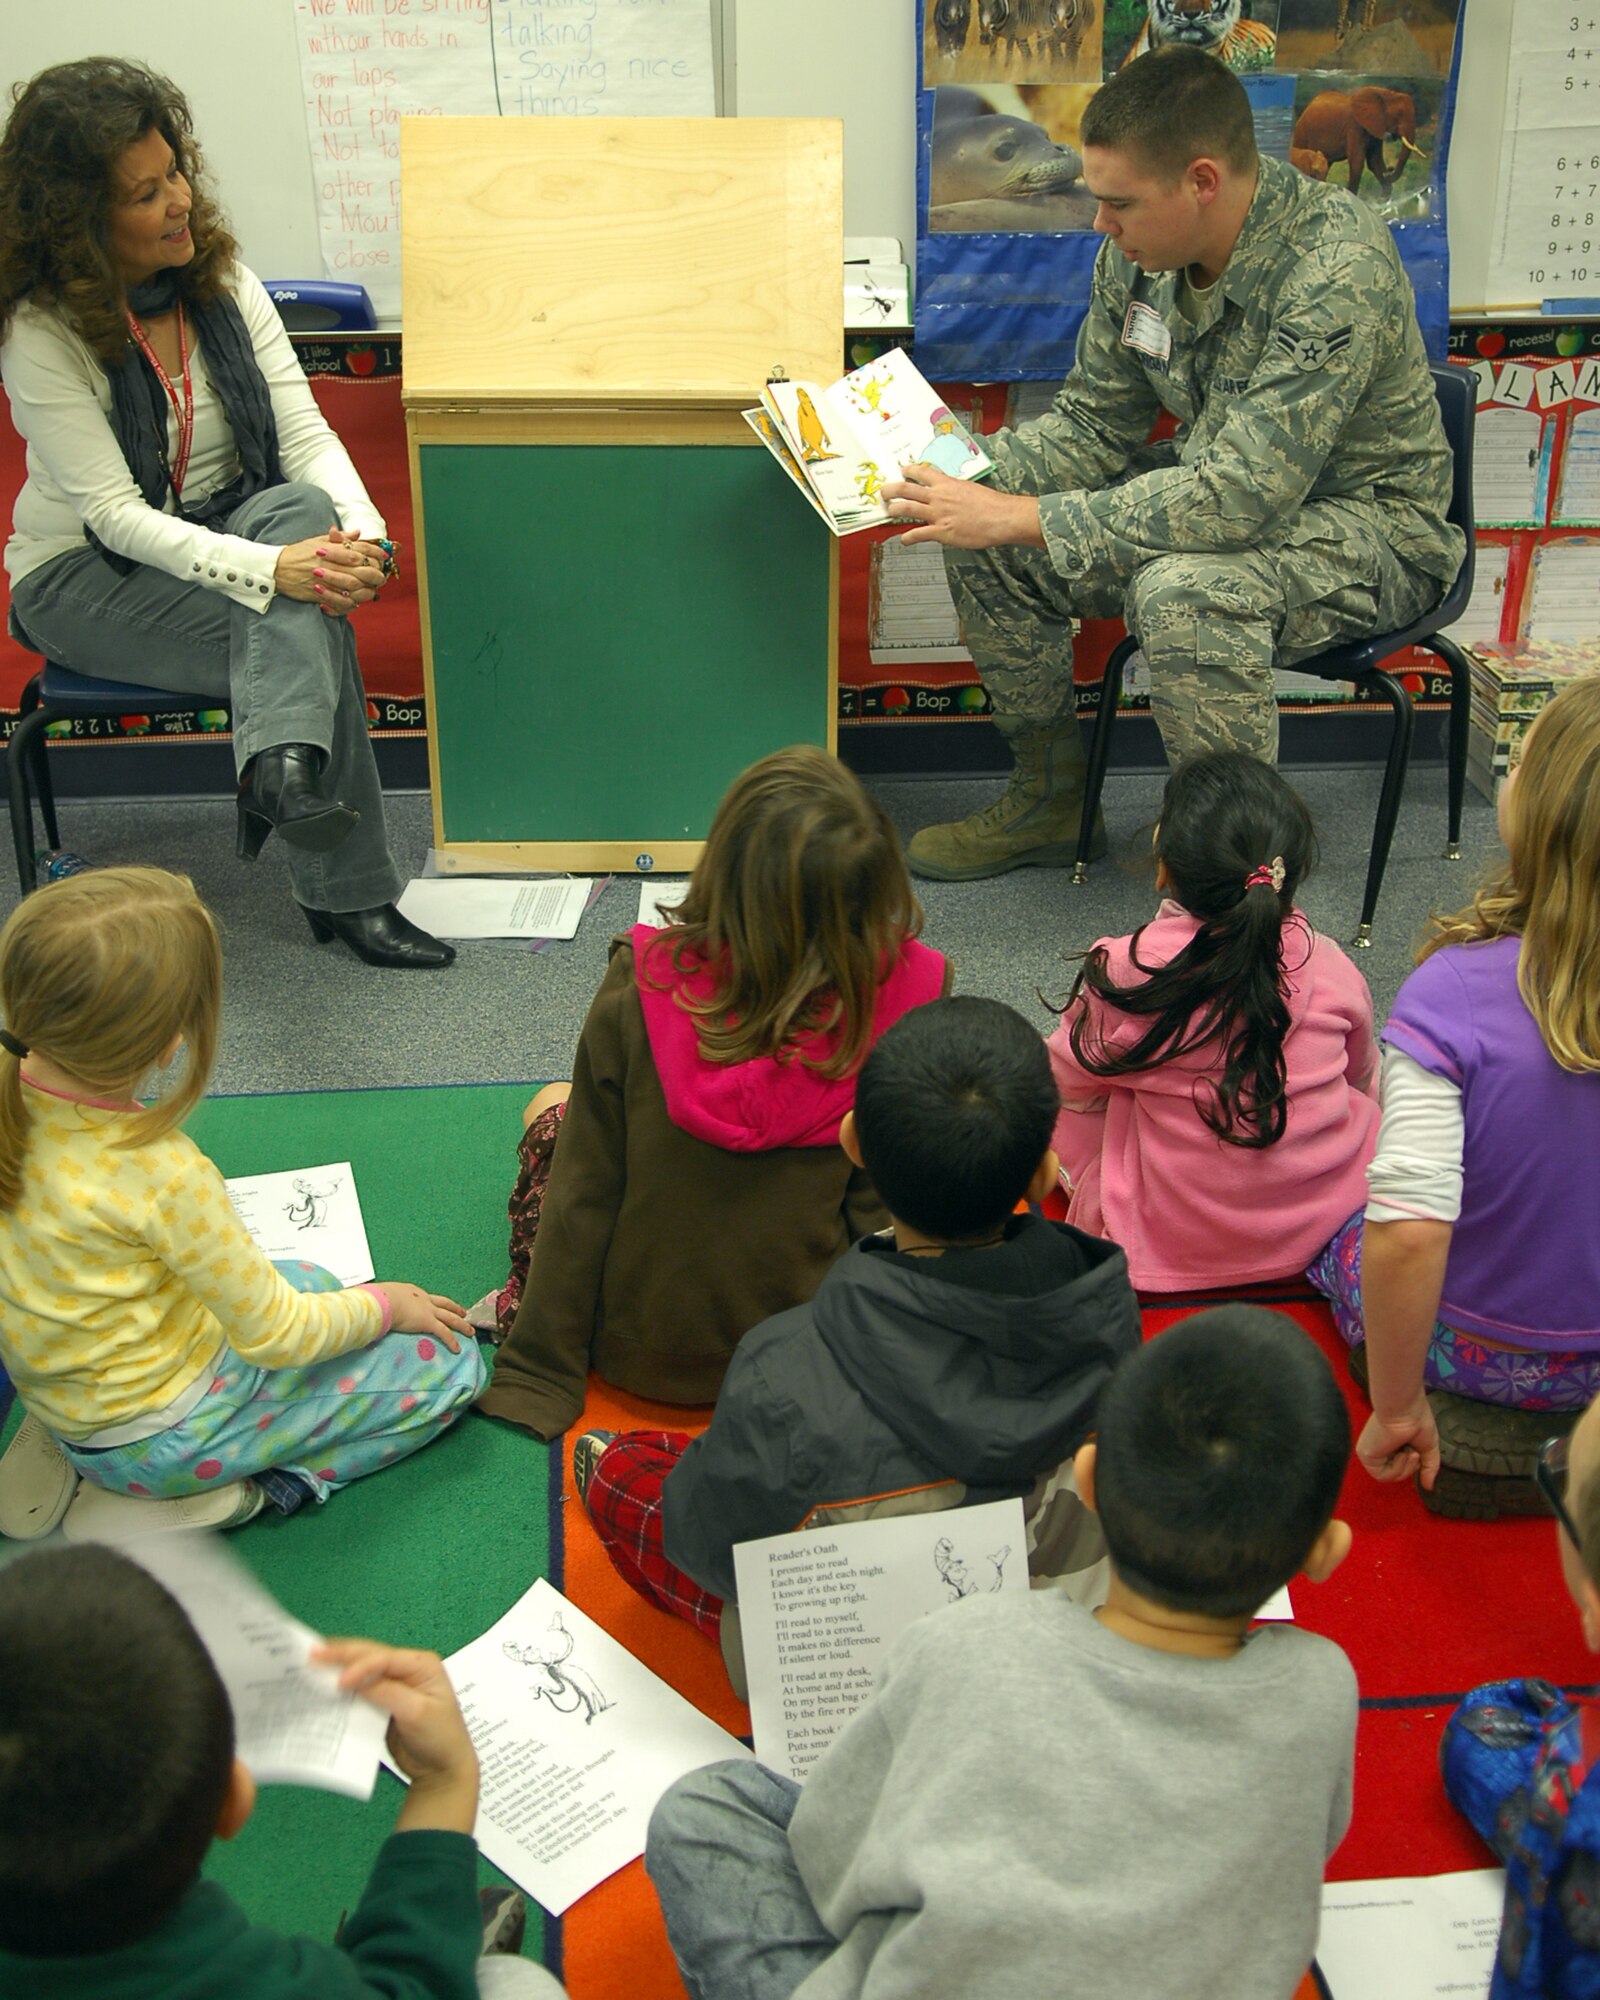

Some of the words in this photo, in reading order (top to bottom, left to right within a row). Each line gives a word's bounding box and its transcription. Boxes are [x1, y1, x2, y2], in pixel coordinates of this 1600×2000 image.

[1570, 17, 1579, 31] 3
[382, 18, 429, 48] hands
[440, 32, 458, 48] in
[501, 11, 592, 63] talking
[1567, 48, 1575, 60] 4
[628, 58, 692, 79] nice
[312, 72, 339, 89] our
[1565, 77, 1573, 90] 5
[1557, 157, 1566, 170] 6
[1591, 156, 1599, 169] 6
[321, 170, 374, 201] other
[1555, 186, 1563, 198] 7
[1589, 184, 1597, 197] 7
[341, 202, 401, 234] Mout
[1551, 214, 1560, 227] 8
[1585, 212, 1593, 225] 8
[1548, 242, 1557, 255] 9
[1582, 240, 1590, 253] 9
[1529, 270, 1544, 283] 10
[1572, 268, 1587, 281] 10
[1126, 310, 1138, 339] VISITOR
[1448, 331, 1468, 347] at
[311, 345, 331, 358] like
[302, 360, 341, 371] chool
[916, 692, 950, 711] dog
[386, 704, 421, 725] dog
[769, 1548, 811, 1563] Reader's
[813, 1543, 838, 1555] Oath
[770, 1569, 774, 1577] I
[776, 1564, 813, 1578] promise
[828, 1557, 848, 1568] read
[771, 1577, 794, 1588] Each
[796, 1576, 813, 1585] day
[816, 1572, 833, 1582] and
[835, 1569, 857, 1579] each
[859, 1566, 884, 1578] night.
[772, 1592, 776, 1600] I
[779, 1590, 804, 1599] know
[807, 1586, 821, 1595] it's
[823, 1584, 837, 1593] the
[839, 1583, 856, 1591] key
[774, 1603, 786, 1611] To
[788, 1599, 827, 1612] growing
[829, 1597, 841, 1606] up
[843, 1593, 868, 1604] right.
[775, 1620, 788, 1630] I'll
[790, 1617, 811, 1627] read
[777, 1632, 789, 1641] I'll
[791, 1629, 812, 1639] read
[833, 1624, 865, 1635] crowd.
[778, 1645, 785, 1653] It
[788, 1642, 817, 1652] makes
[834, 1636, 881, 1647] difference
[779, 1656, 788, 1665] If
[789, 1654, 815, 1663] silent
[829, 1649, 853, 1660] loud.
[781, 1673, 793, 1683] I'll
[796, 1671, 816, 1682] read
[829, 1671, 844, 1679] my
[783, 1687, 794, 1695] At
[796, 1685, 822, 1694] home
[824, 1681, 842, 1691] and
[783, 1699, 798, 1707] On
[800, 1698, 815, 1707] my
[817, 1695, 839, 1704] bean
[841, 1693, 859, 1703] bag
[784, 1711, 798, 1722] By
[800, 1710, 815, 1718] the
[817, 1707, 833, 1716] fire
[786, 1728, 810, 1739] Each
[812, 1726, 835, 1735] book
[788, 1743, 808, 1752] Puts
[810, 1741, 831, 1749] sma
[791, 1767, 808, 1777] The
